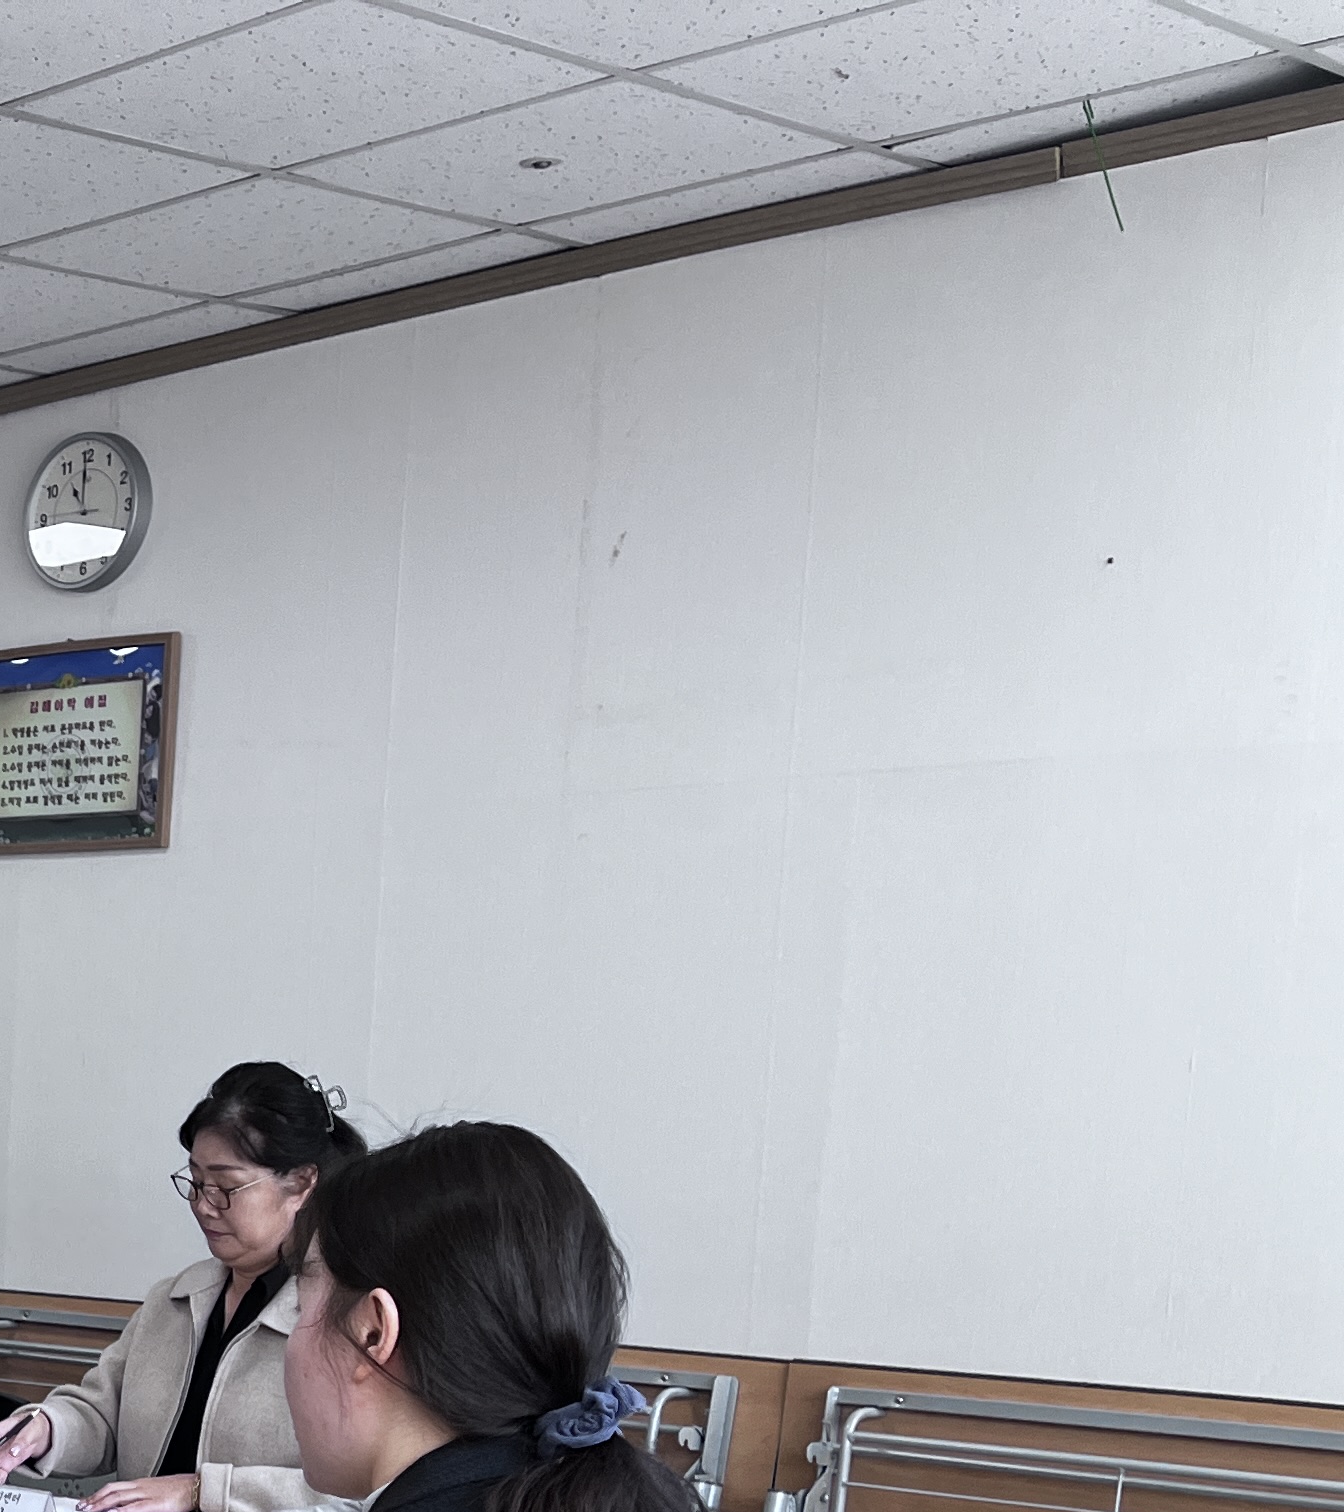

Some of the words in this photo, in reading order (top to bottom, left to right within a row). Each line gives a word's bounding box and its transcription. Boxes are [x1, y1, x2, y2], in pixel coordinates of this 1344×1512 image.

[82, 449, 95, 463] 12
[107, 452, 112, 466] 1
[61, 461, 72, 475] 11
[120, 471, 129, 485] 2
[47, 484, 58, 499] 10
[124, 497, 133, 512] 3
[40, 514, 48, 527] 9
[79, 562, 87, 575] 6
